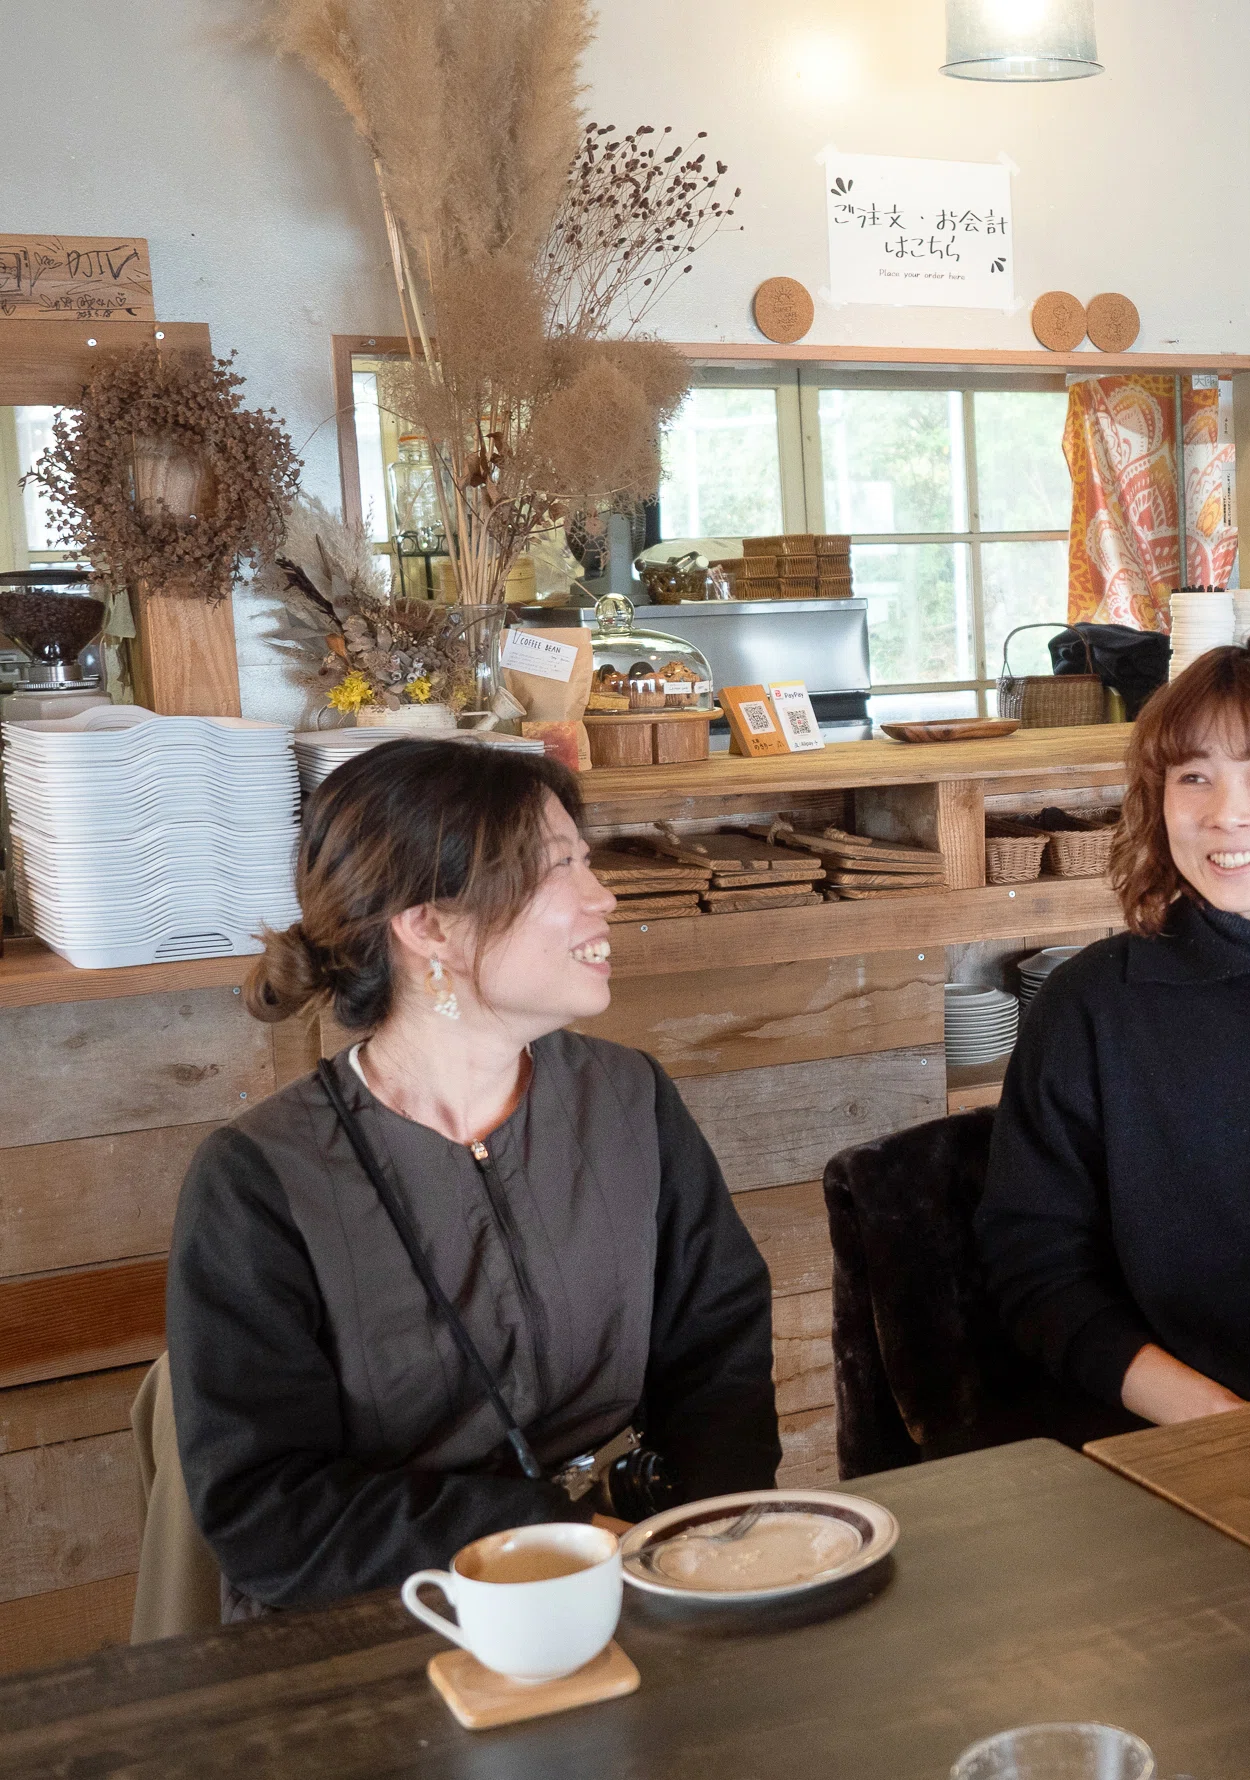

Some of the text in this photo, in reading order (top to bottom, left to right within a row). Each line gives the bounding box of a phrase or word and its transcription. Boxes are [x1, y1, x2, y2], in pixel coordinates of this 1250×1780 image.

[834, 203, 1008, 235] ご注文・お会計
[885, 236, 960, 262] はこちら
[879, 269, 900, 277] Place
[924, 270, 945, 279] order
[520, 637, 562, 654] COFFEE BEAN
[784, 691, 804, 700] PayPay
